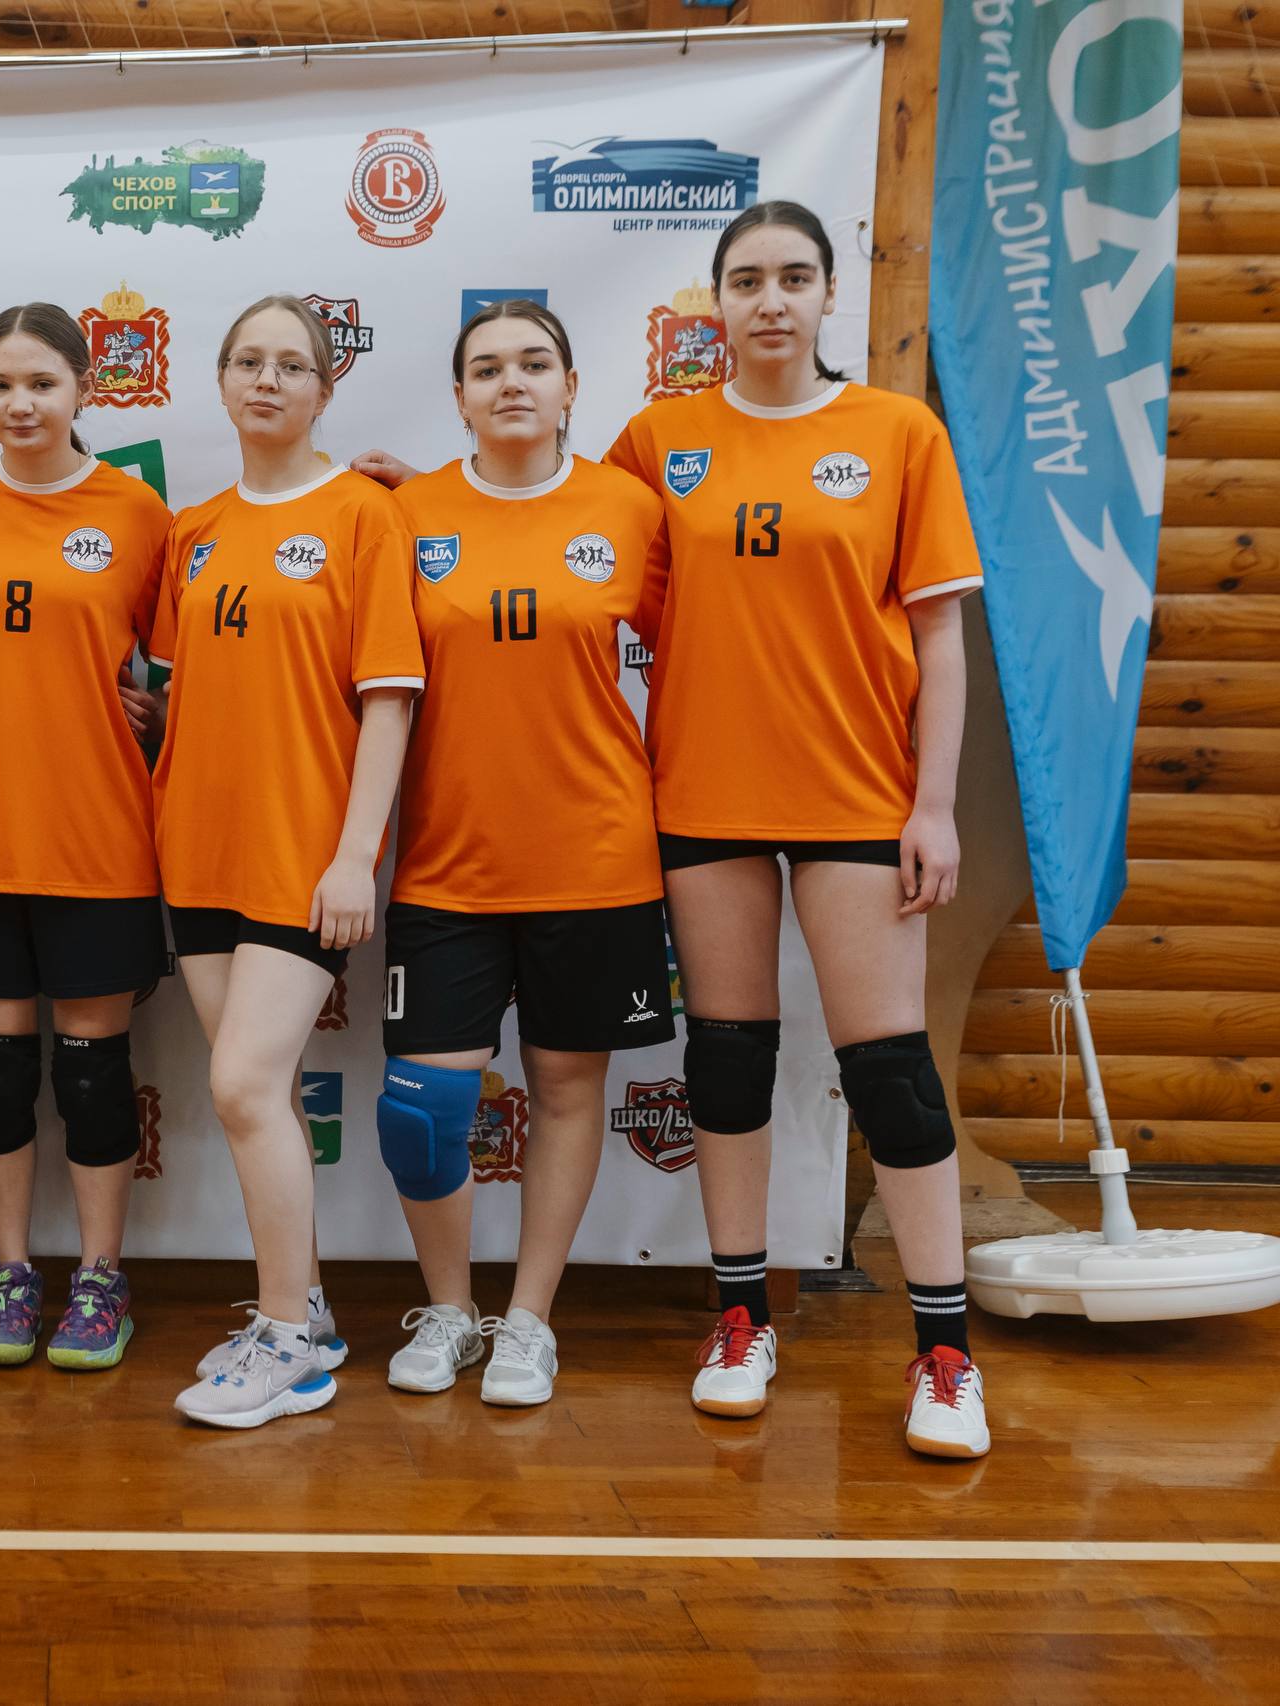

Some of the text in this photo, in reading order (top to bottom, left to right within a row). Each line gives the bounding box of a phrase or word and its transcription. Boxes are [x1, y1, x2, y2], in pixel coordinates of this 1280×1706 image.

[112, 176, 177, 191] ЧЕХОВ
[552, 173, 627, 184] ДВОРЕЦ СПОРТА
[554, 179, 737, 209] ОЛИМПИЙСКИЙ
[112, 195, 177, 210] СПОРТ
[613, 217, 731, 232] ЦЕНТР ПРИТЯЖЕН
[670, 461, 702, 476] ЧШЛ
[735, 502, 782, 557] 13
[420, 549, 454, 562] ЧШЛ
[5, 579, 33, 633] 8
[214, 584, 248, 638] 14
[489, 588, 537, 642] 10
[623, 1010, 659, 1023] JÖGEL
[388, 1074, 425, 1090] DEMIX
